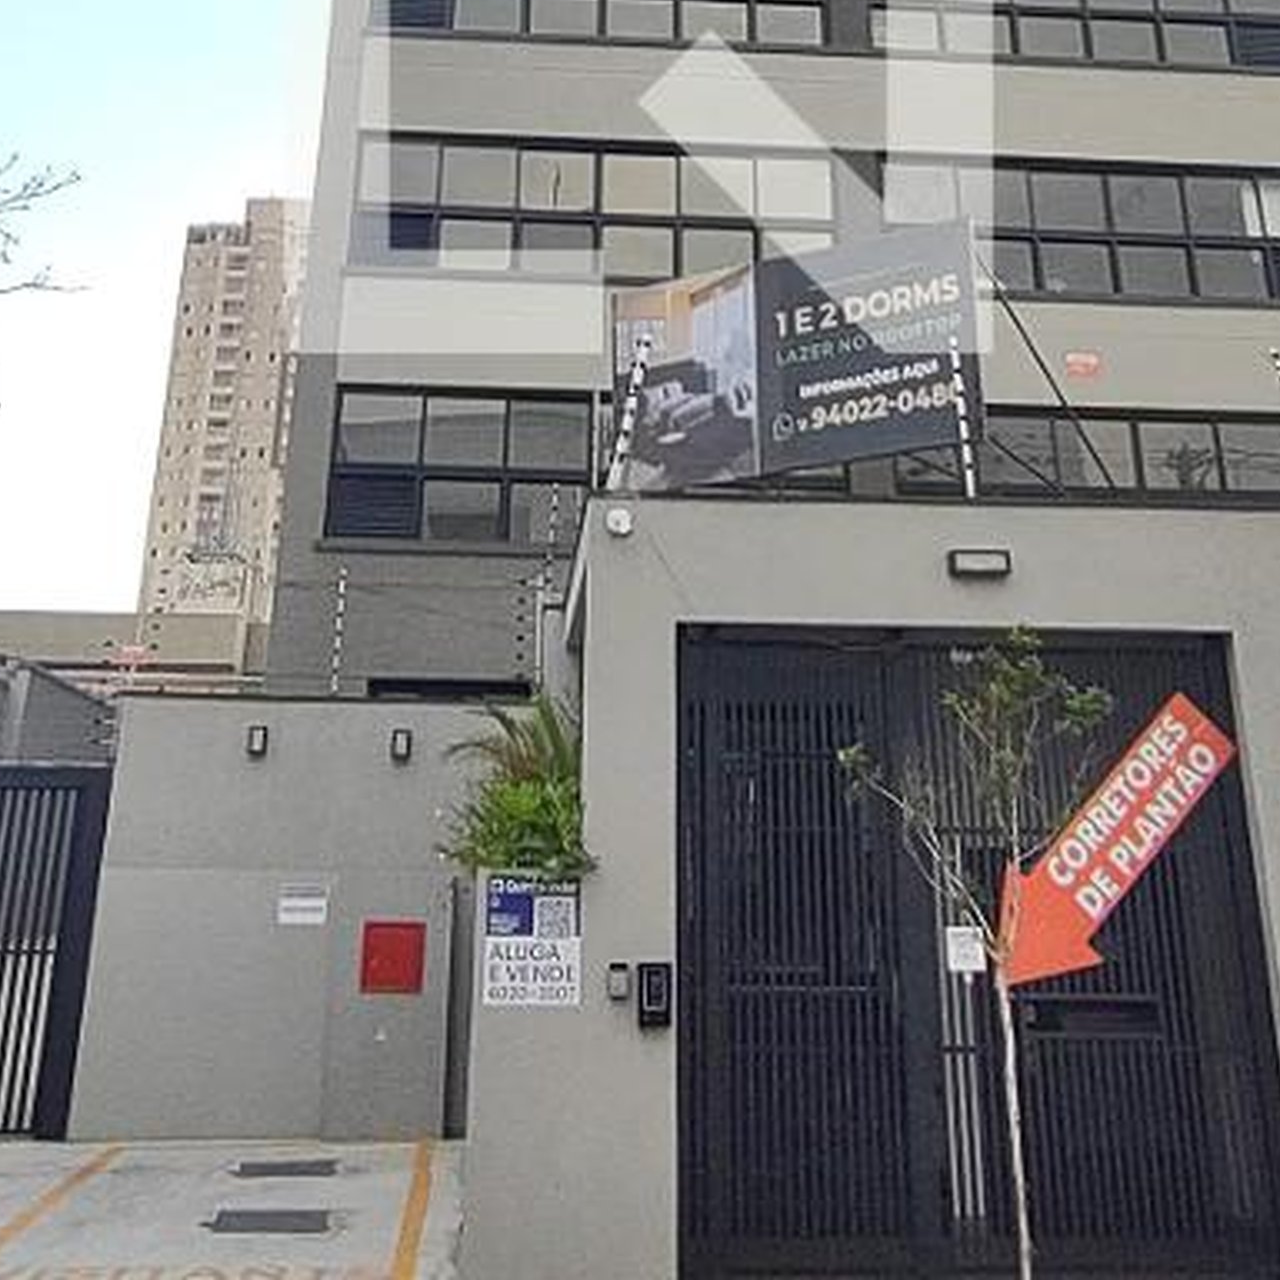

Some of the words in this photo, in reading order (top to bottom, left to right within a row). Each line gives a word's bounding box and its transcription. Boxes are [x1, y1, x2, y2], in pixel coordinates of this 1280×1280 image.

[775, 311, 787, 337] 1
[794, 306, 814, 335] E
[819, 303, 838, 329] 2
[843, 274, 961, 324] DORMS
[775, 341, 834, 367] LAZER
[837, 333, 867, 355] NO
[903, 358, 940, 380] AQUI
[1047, 716, 1188, 887] CORRETORES
[1075, 869, 1120, 919] DE
[1109, 744, 1216, 875] PLANTÃO
[488, 943, 560, 961] ALUGA
[489, 964, 501, 982] E
[505, 964, 577, 982] VENDE
